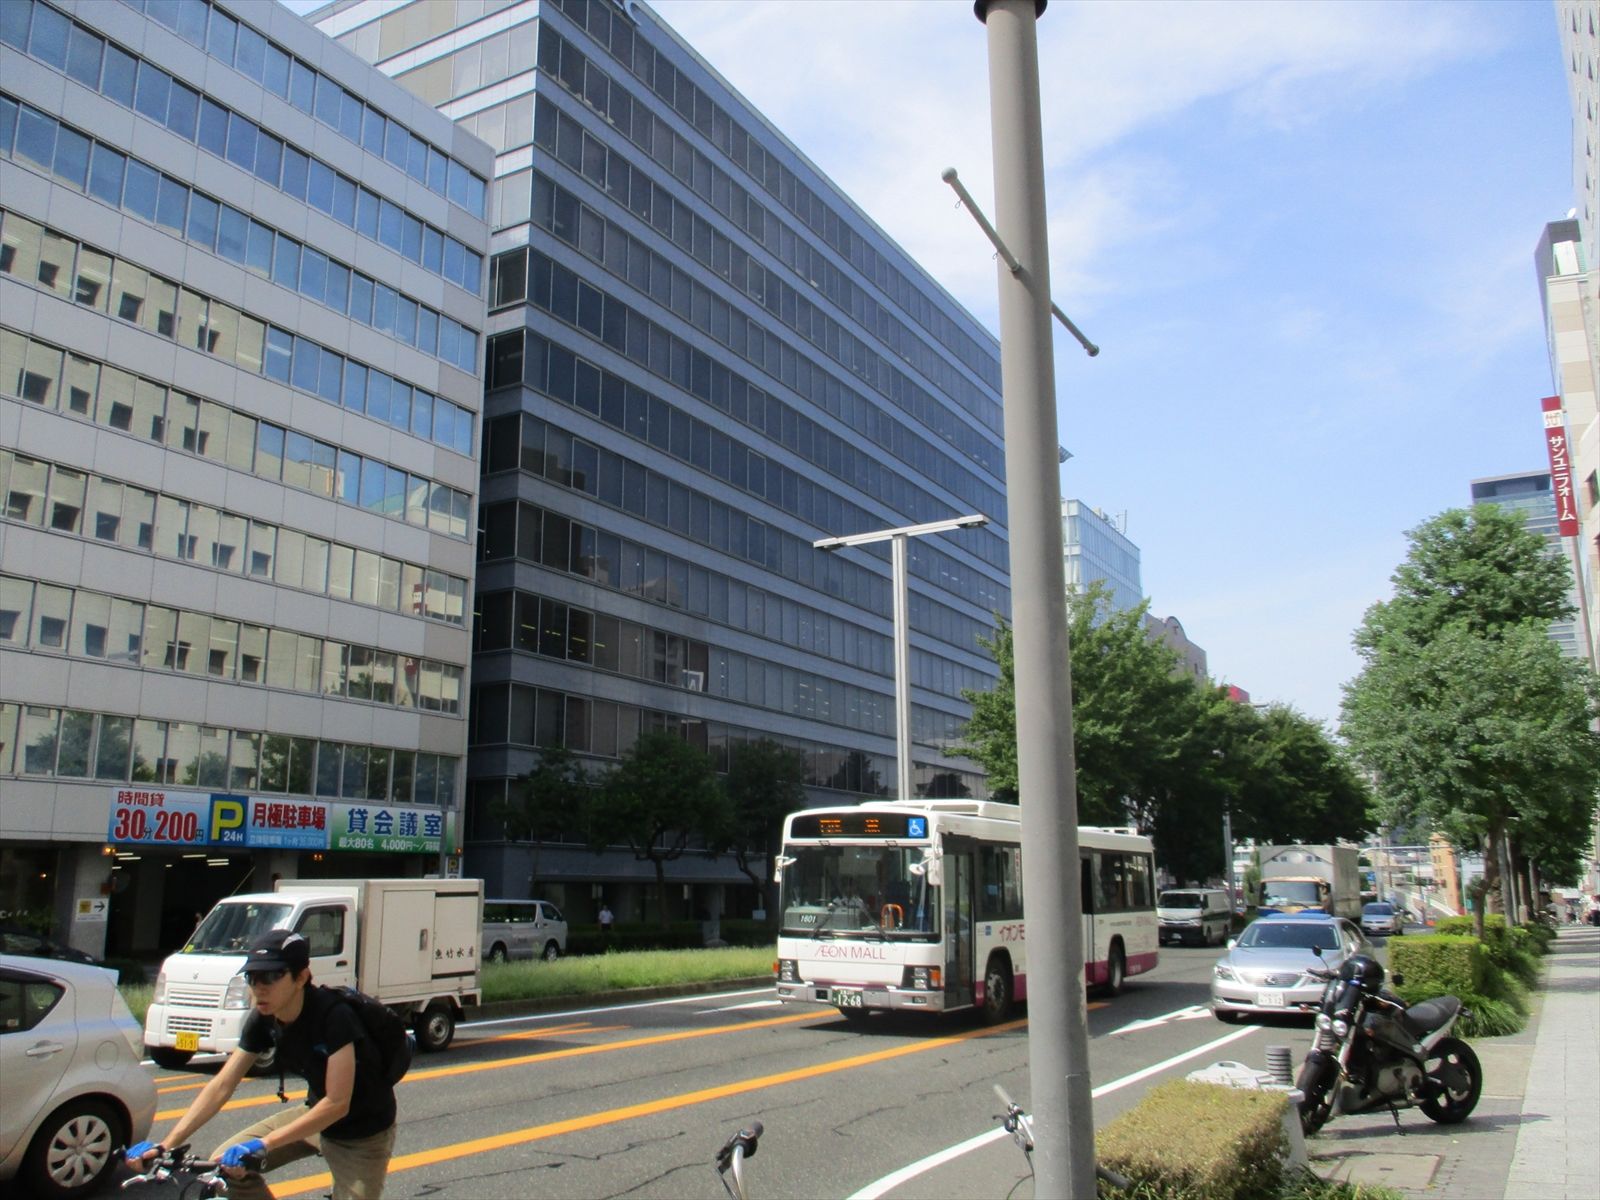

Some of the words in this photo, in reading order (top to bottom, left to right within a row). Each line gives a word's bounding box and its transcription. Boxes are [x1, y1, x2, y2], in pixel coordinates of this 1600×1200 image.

[1549, 435, 1576, 521] サンユニフォーム
[117, 790, 165, 807] 時間貸
[210, 800, 244, 841] P
[252, 802, 326, 830] 月極駐車場
[347, 808, 441, 837] 貸会議室
[223, 830, 244, 842] 24H
[851, 946, 886, 960] MALL
